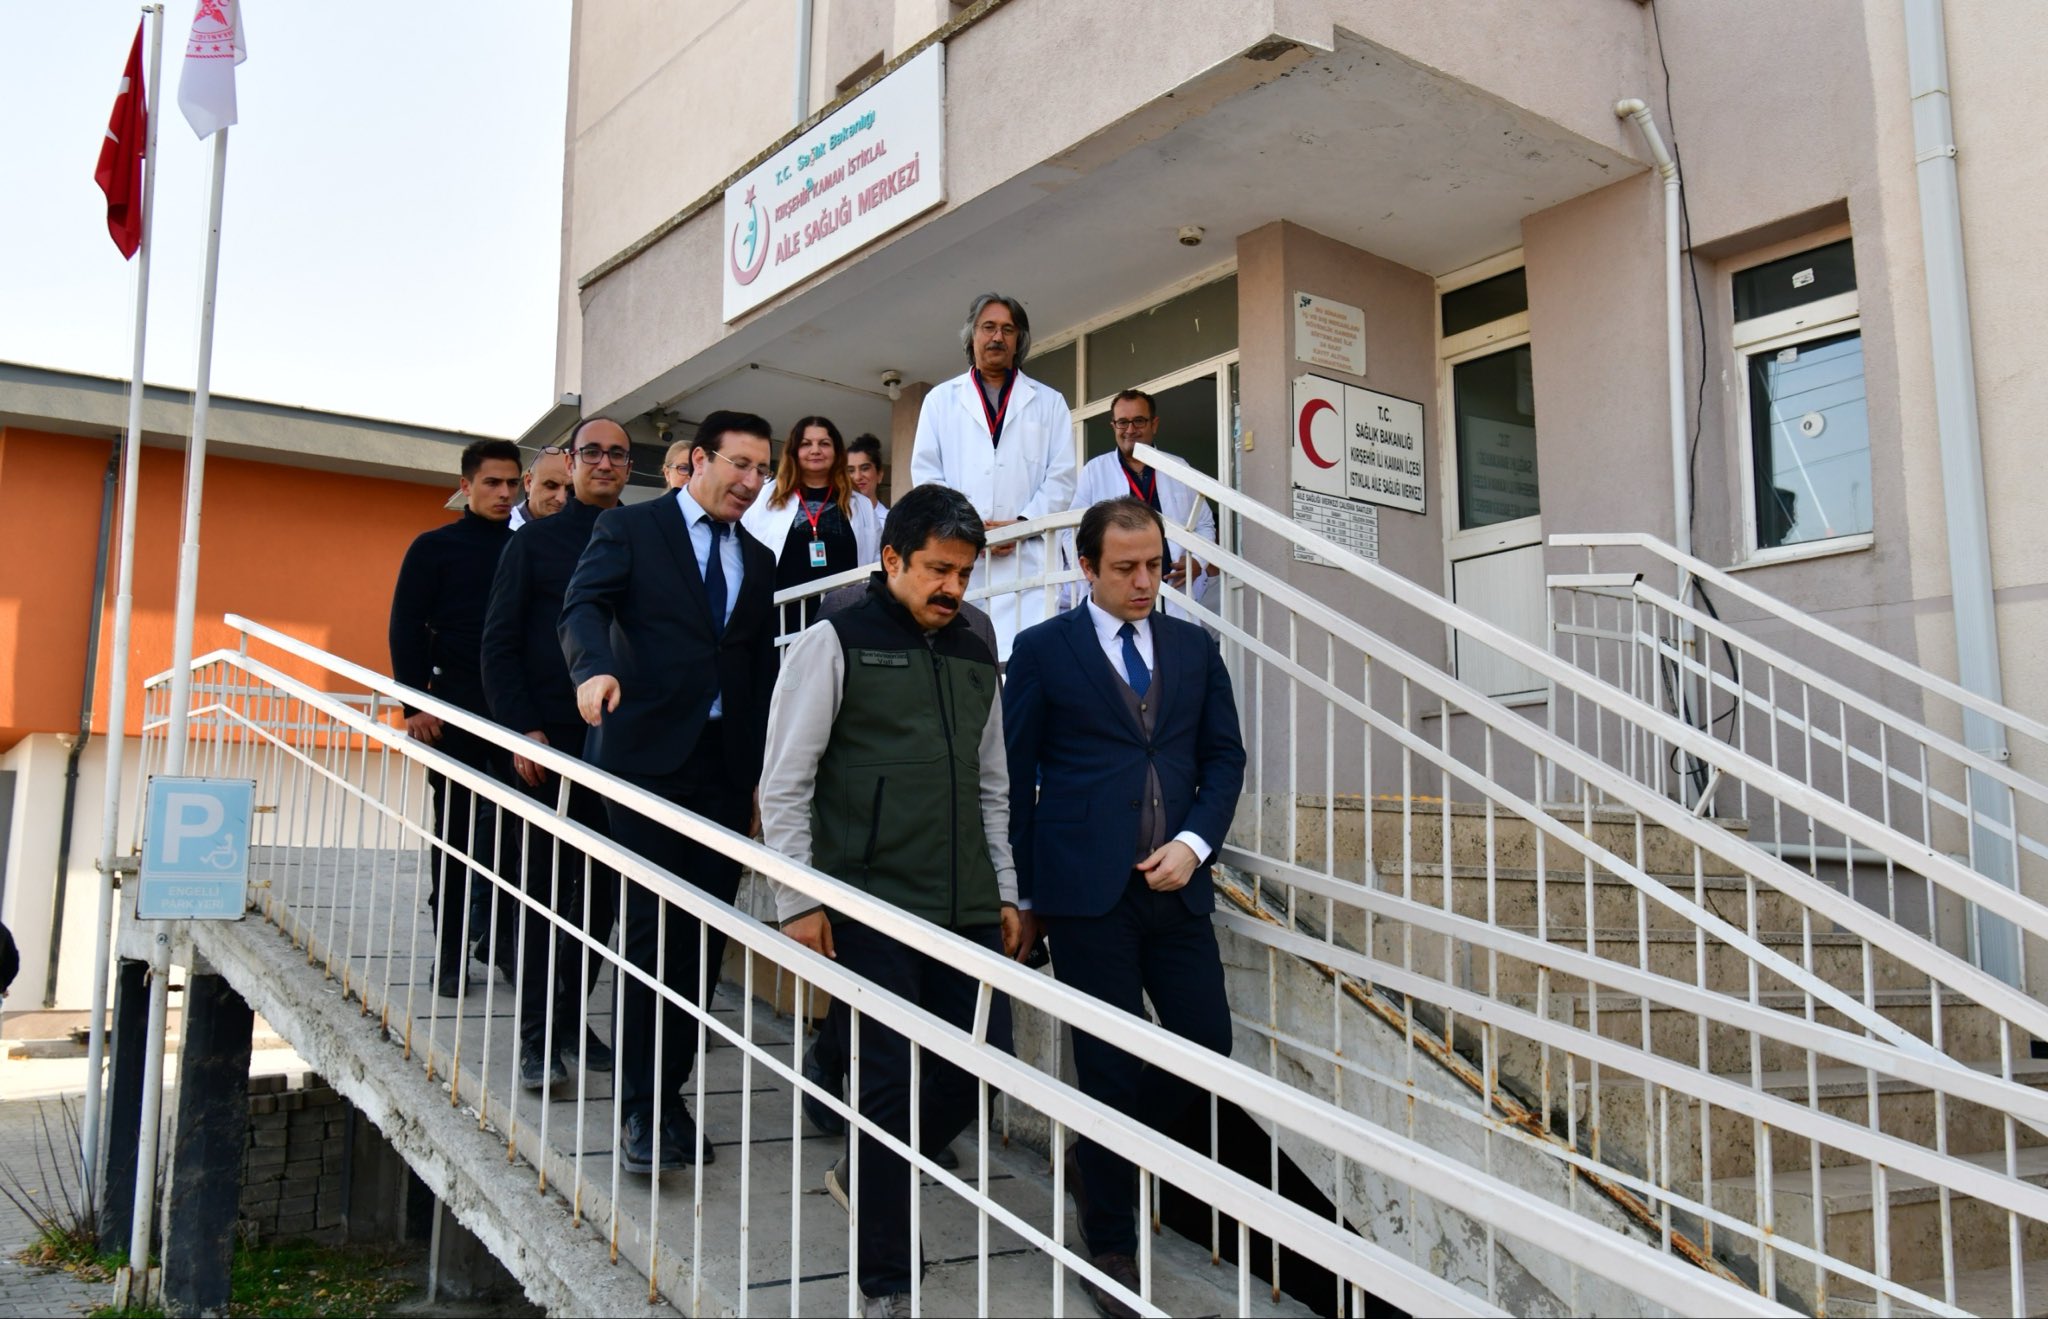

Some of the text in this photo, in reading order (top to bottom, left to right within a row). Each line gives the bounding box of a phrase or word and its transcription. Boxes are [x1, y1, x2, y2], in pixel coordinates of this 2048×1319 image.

[829, 109, 876, 150] Bakanlığı
[813, 165, 844, 199] KAMAN
[847, 139, 887, 176] İSTİKLAL
[775, 152, 920, 267] AİLE SAĞLIĞI MERKEZİ
[1377, 405, 1392, 423] T.C.
[1355, 422, 1413, 451] SAĞLIK BAKANLIĞI
[1350, 446, 1376, 467] KIRŞEHİR
[1384, 454, 1404, 474] KAMAN
[1382, 476, 1400, 497] SAĞLIĞI
[161, 792, 224, 864] P
[161, 897, 224, 909] PARK YERİ
[168, 884, 220, 897] ENGELLİ
